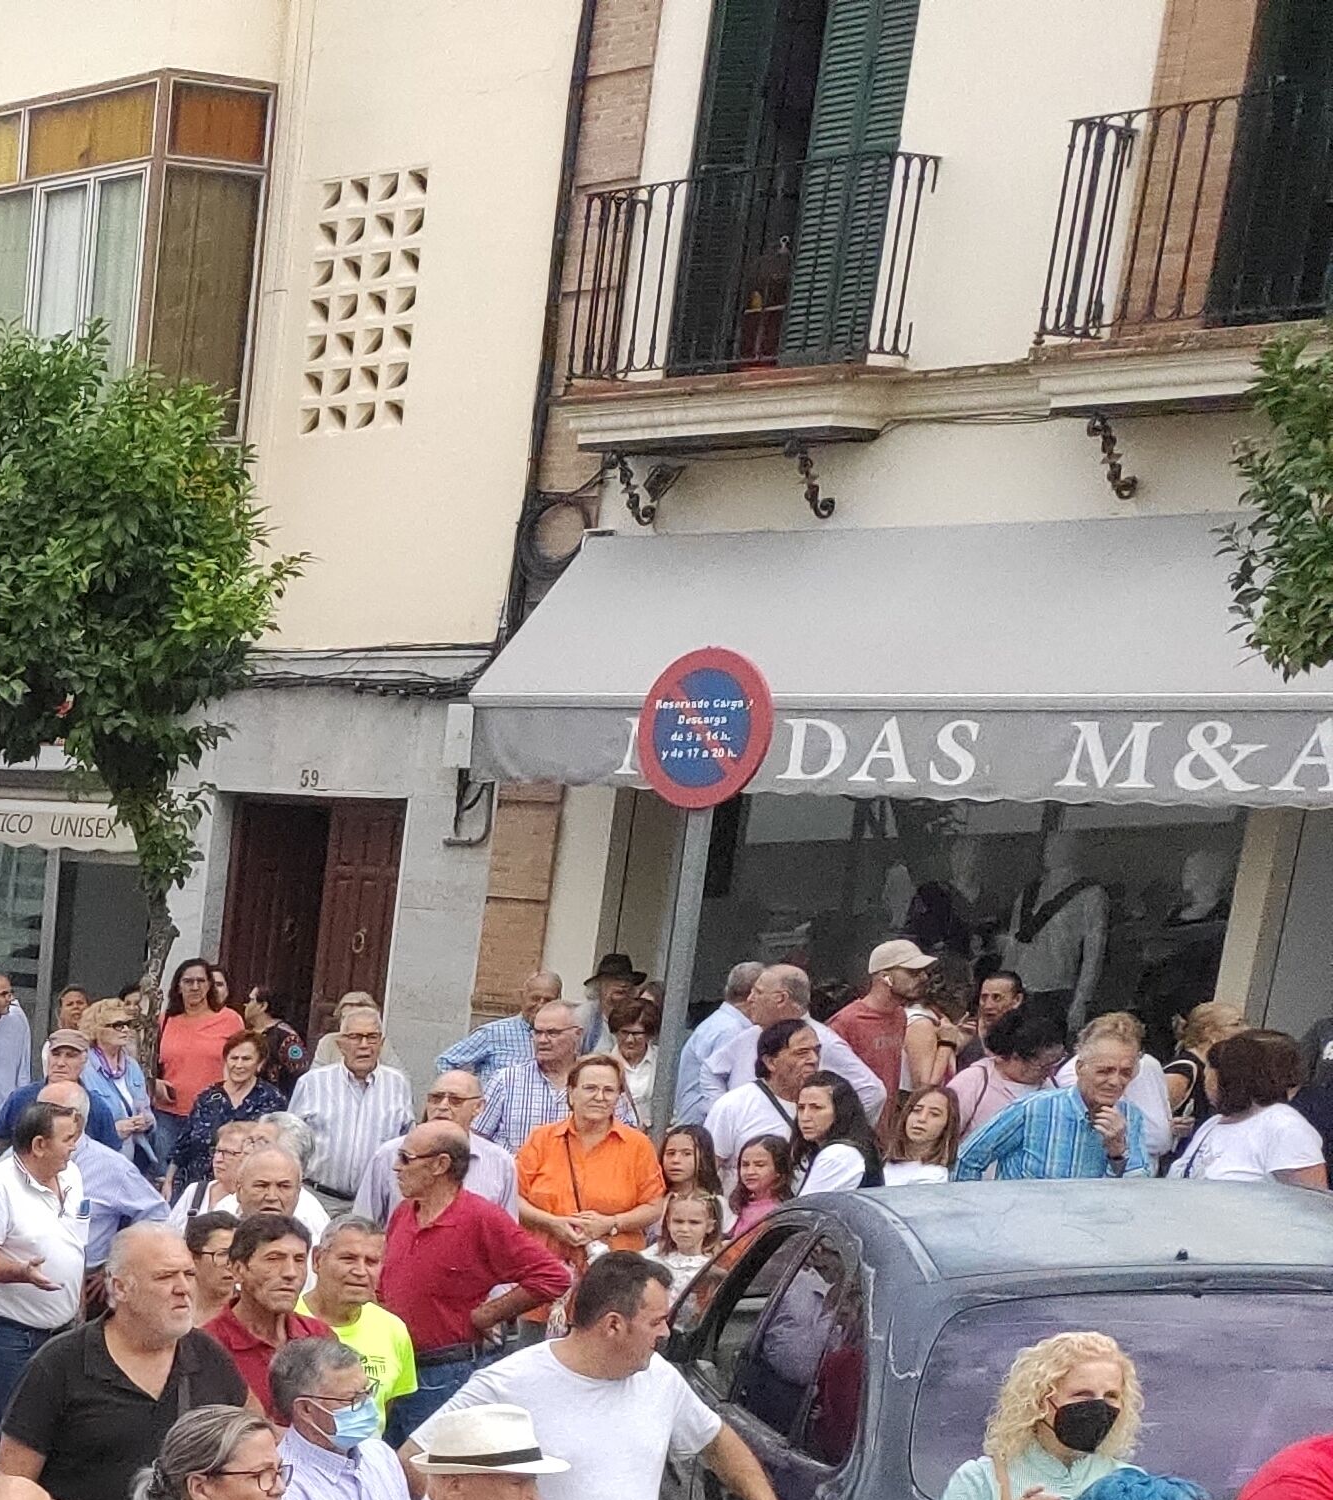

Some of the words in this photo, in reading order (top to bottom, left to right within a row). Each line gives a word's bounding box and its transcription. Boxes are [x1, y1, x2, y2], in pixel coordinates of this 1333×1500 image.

[713, 699, 744, 711] Carga
[678, 714, 728, 727] Descarga
[671, 732, 684, 742] de
[706, 732, 719, 742] 16
[614, 716, 983, 788] DAS
[661, 749, 669, 761] y
[671, 748, 684, 758] de
[687, 748, 699, 758] 17
[702, 748, 709, 758] a
[713, 748, 725, 758] 20
[299, 769, 320, 788] 59
[50, 815, 118, 839] UNISEX
